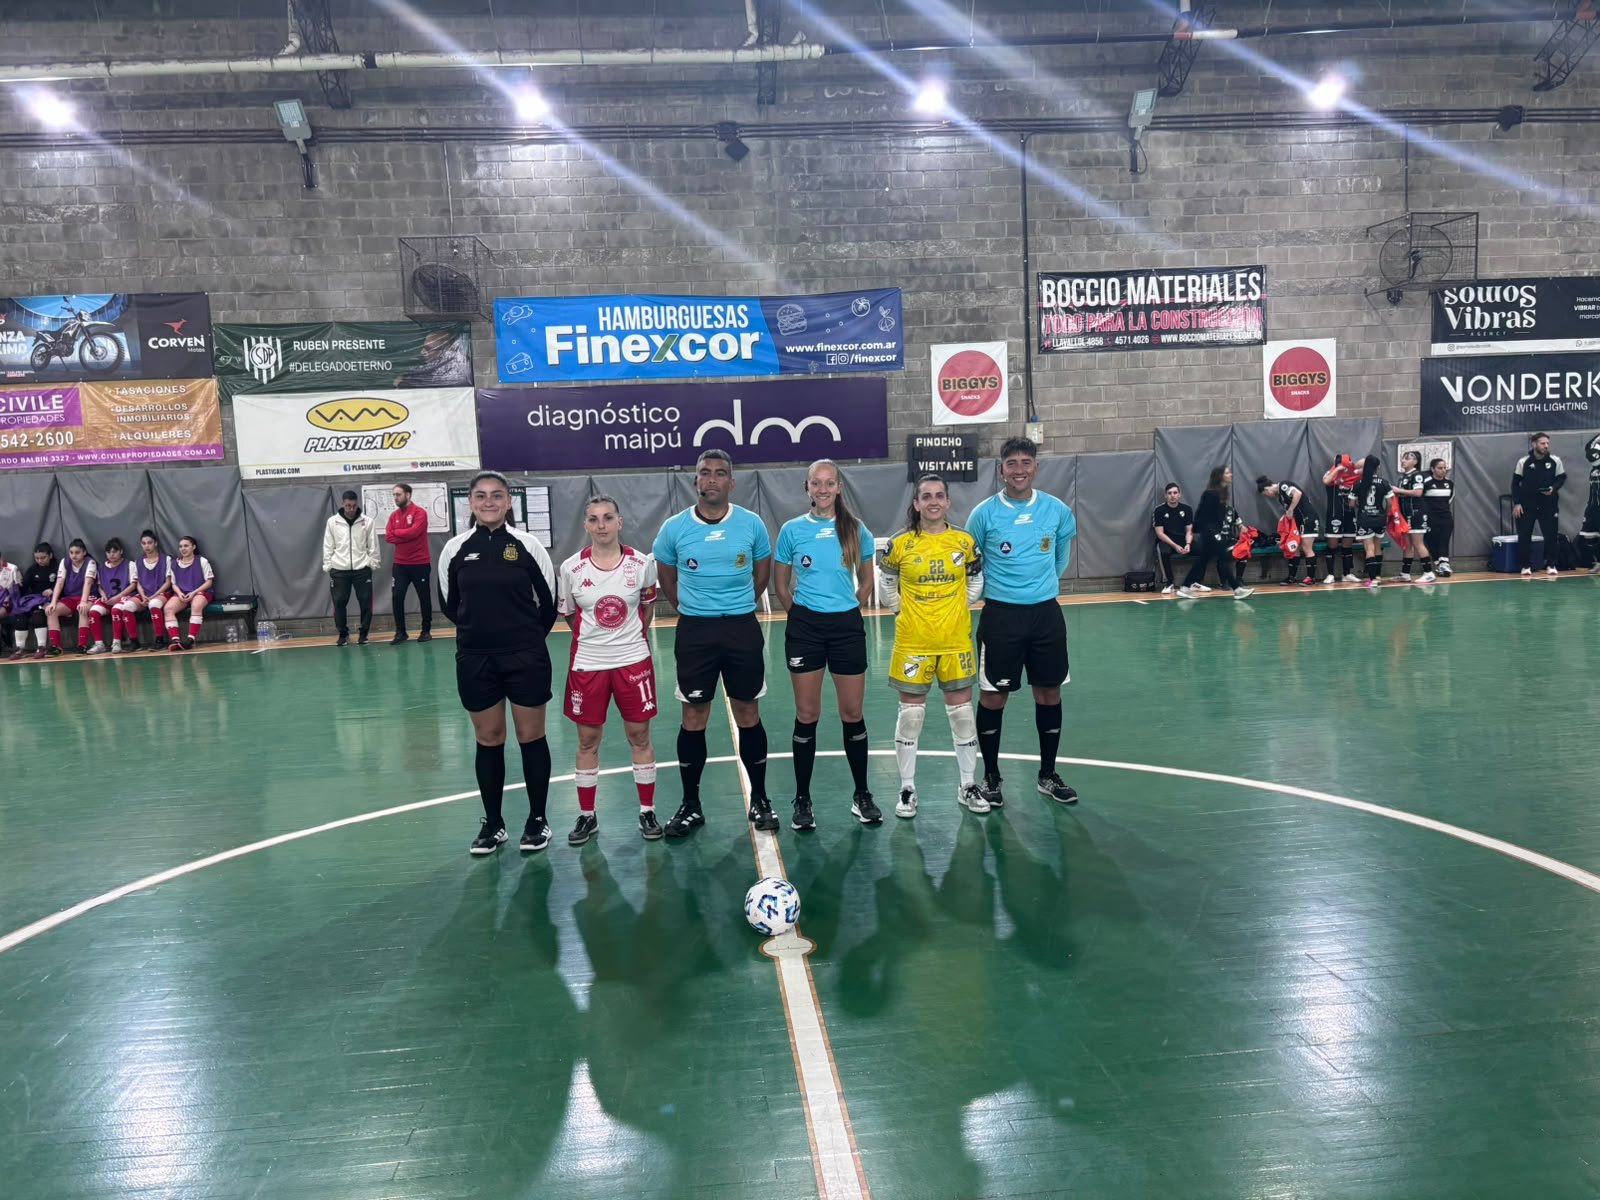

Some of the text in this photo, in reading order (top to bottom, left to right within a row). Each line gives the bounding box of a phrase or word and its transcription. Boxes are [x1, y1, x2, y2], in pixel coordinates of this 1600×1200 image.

[1042, 272, 1262, 307] BOCCIO MATERIALES
[598, 304, 749, 331] HAMBURGUESAS
[1044, 313, 1084, 334] TODO
[1086, 311, 1125, 332] PARA
[1128, 311, 1148, 331] LA
[148, 334, 205, 350] CORVEN
[293, 339, 386, 351] RUBEN PRESENTE
[545, 324, 760, 366] Finexcor
[785, 341, 897, 353] www.finexcor.com.ar
[288, 360, 393, 372] #DELEGADOETERNO
[942, 376, 999, 391] BIGGYS
[1273, 372, 1327, 387] BIGGYS
[114, 385, 187, 395] TASACIONES
[115, 403, 188, 413] DESARROLLOS
[1461, 401, 1588, 415] OBSESSED WITH LIGHTING
[0, 414, 65, 425] ROPIEDADES
[116, 413, 191, 423] INMOBILIARIOS
[527, 402, 680, 430] diagnóstico
[0, 431, 74, 448] 542-2600
[119, 430, 192, 441] ALQUILERES
[304, 431, 411, 453] PLASTICAVC
[604, 426, 681, 453] maipú
[916, 437, 962, 447] PINOCHO
[951, 449, 956, 458] 1
[918, 461, 974, 471] VISITANTE
[929, 559, 945, 575] 22
[959, 651, 973, 670] 22
[637, 677, 653, 703] 11
